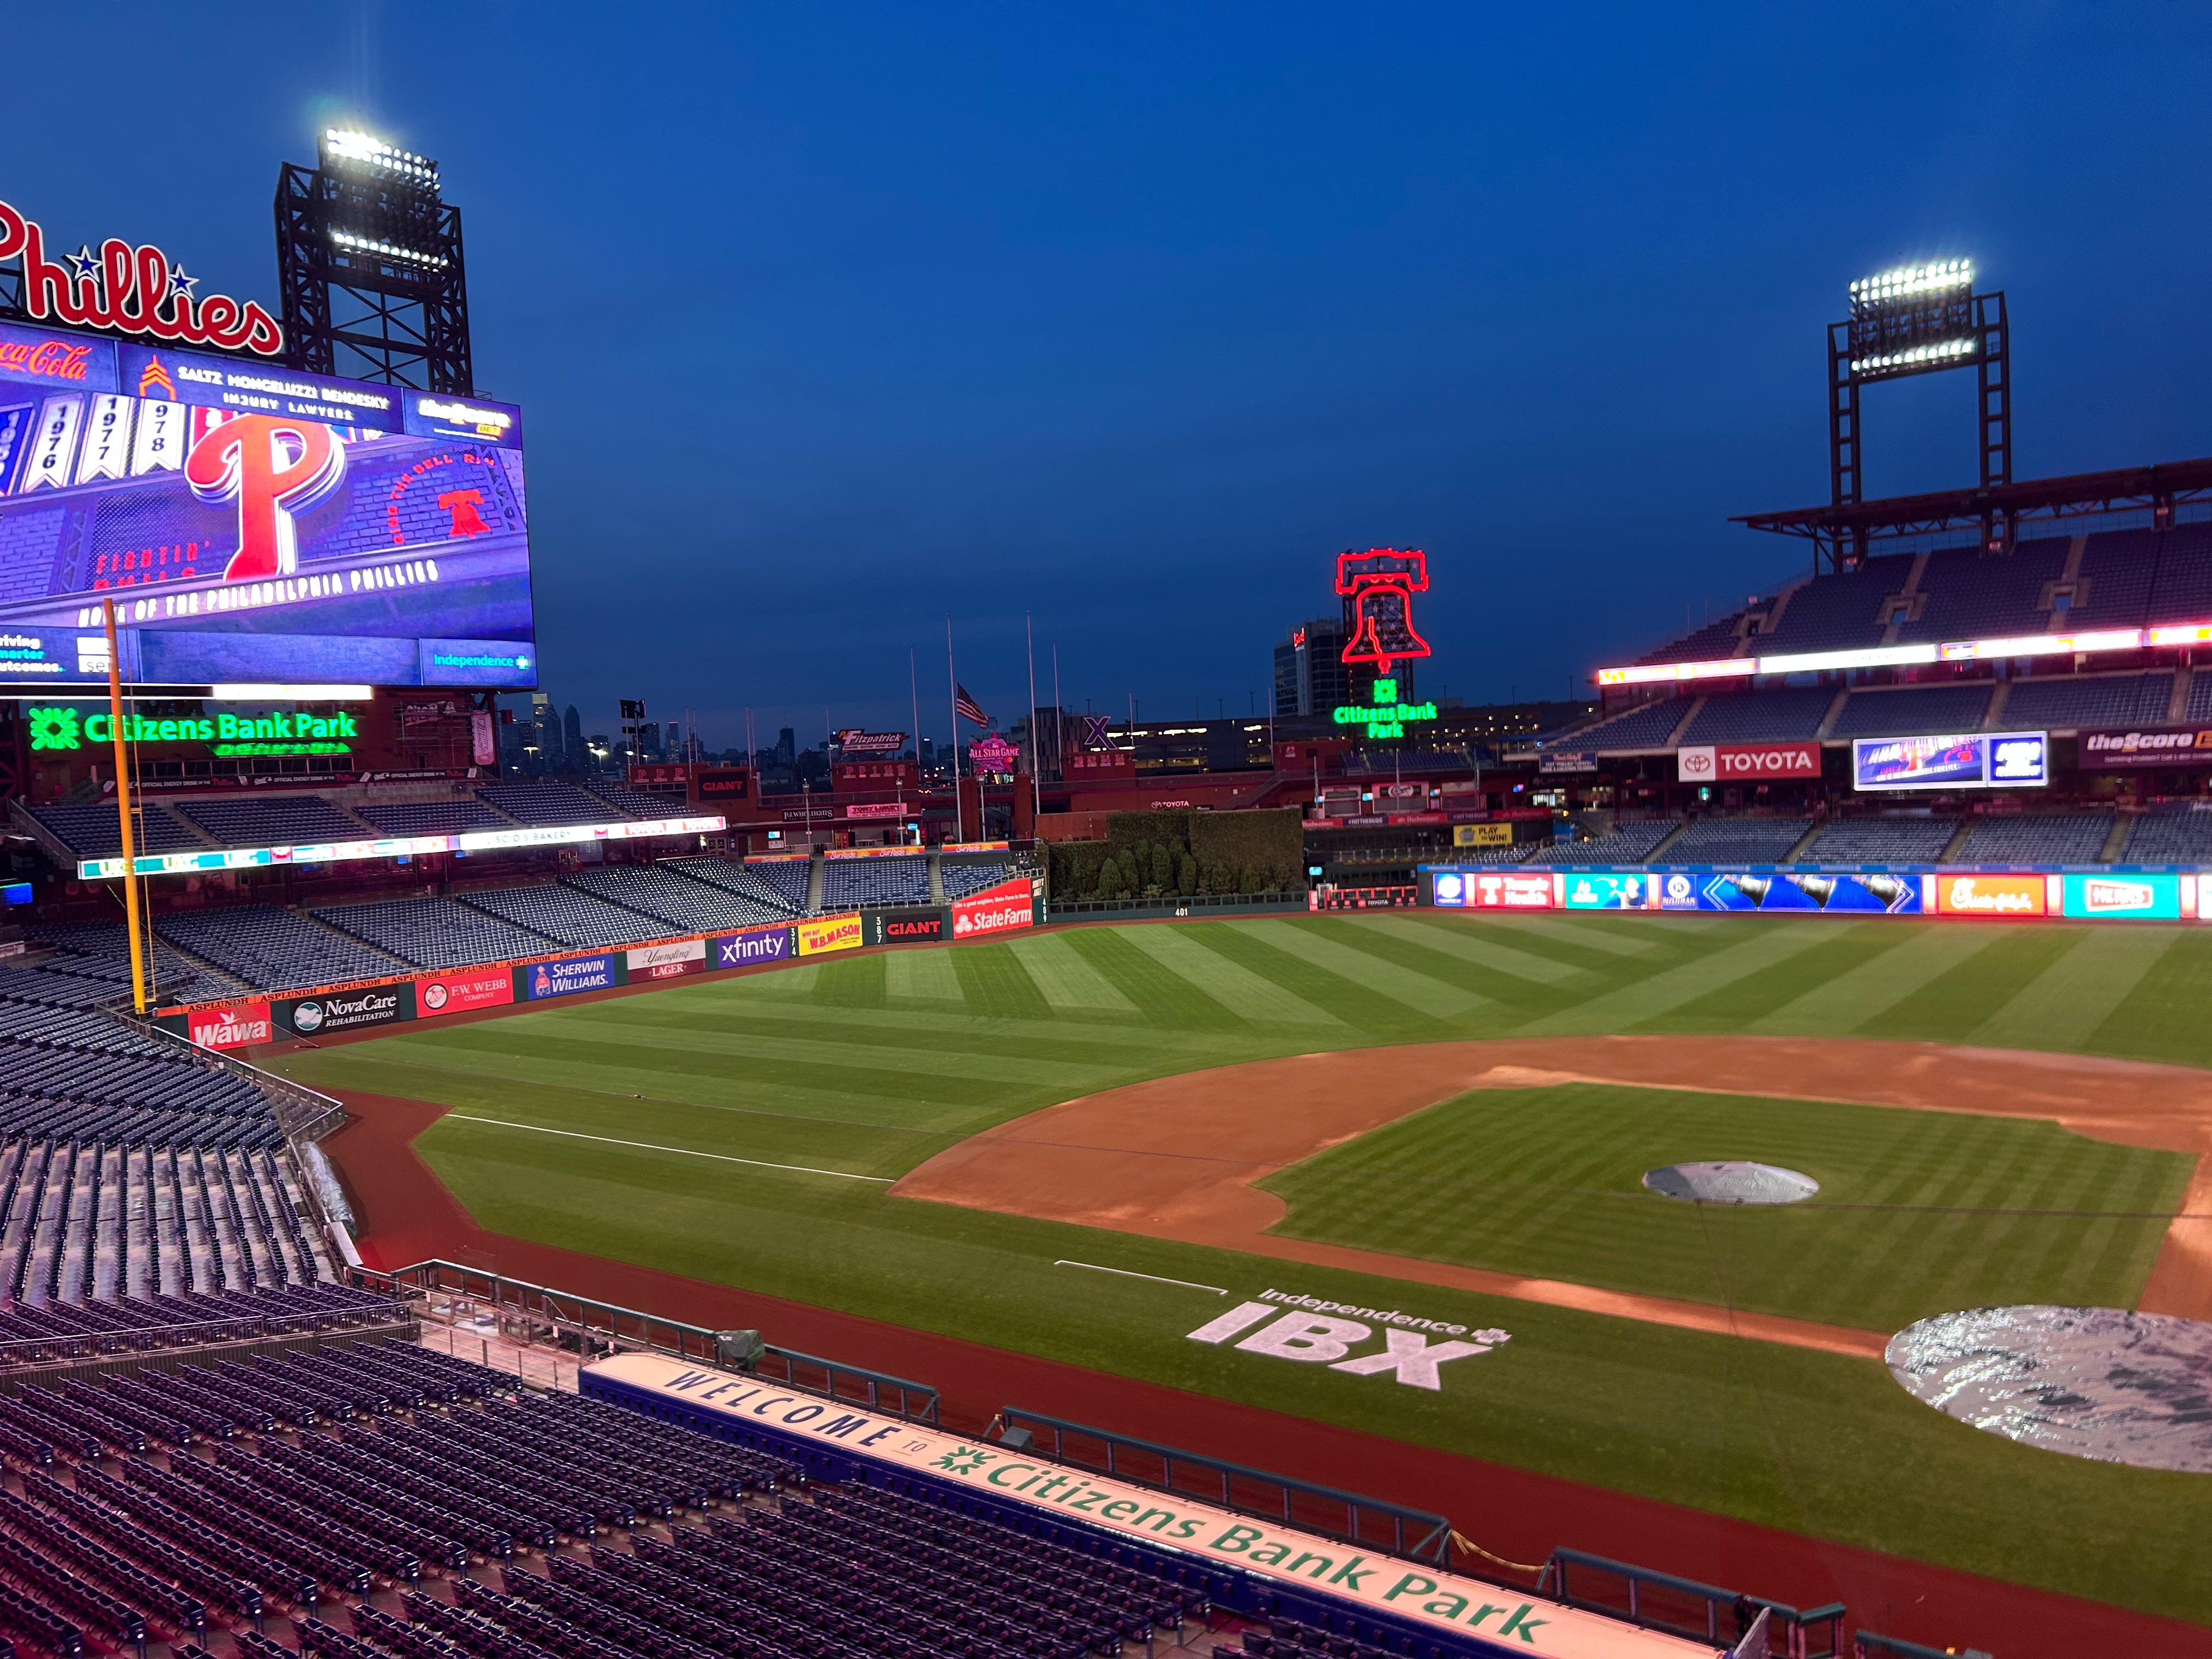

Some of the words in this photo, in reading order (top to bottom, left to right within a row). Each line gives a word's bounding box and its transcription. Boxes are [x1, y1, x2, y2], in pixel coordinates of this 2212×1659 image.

[0, 341, 92, 380] ca-Cola
[178, 366, 224, 385] SALTZ
[228, 374, 318, 399] MONGELUZZI
[321, 387, 390, 410] BENDESKY
[224, 392, 279, 410] INJURY
[289, 402, 354, 421] LAWYERS
[78, 604, 126, 628] HOE
[135, 598, 157, 620] OF
[166, 592, 198, 617] THE
[206, 572, 343, 611] PHILADELPHIA
[351, 559, 438, 592] PHILLIES
[434, 653, 514, 668] Independence
[1334, 706, 1396, 724] Citizens
[1396, 701, 1437, 721] Bank
[218, 712, 294, 740] Bank
[296, 710, 358, 738] Park
[1368, 720, 1404, 738] Park
[983, 748, 1001, 757] STAR
[1001, 747, 1020, 757] GAME
[1720, 751, 1813, 772] TOYOTA
[702, 781, 743, 792] GIANT
[1488, 833, 1506, 842] WIN!
[1175, 907, 1188, 916] 401
[887, 921, 940, 935] GIANT
[260, 988, 318, 1003] ASPLUNDH
[329, 979, 381, 992] ASPLUNDH
[391, 970, 441, 983] ASPLUNDH
[450, 963, 497, 975] ASPLUNDH
[506, 956, 550, 967] ASPLUNDH
[559, 948, 601, 960] ASPLUNDH
[609, 942, 649, 952] ASPLUNDH
[657, 935, 695, 945] ASPLUNDH
[701, 929, 738, 939] ASPLUNDH
[744, 923, 778, 933] ASPLUNDH
[785, 918, 818, 927] ASPLUNDH
[825, 913, 856, 921] ASPLUNDH
[642, 945, 692, 966] Yuengling
[722, 934, 784, 963] xfinity
[552, 960, 605, 978] SHERWIN
[652, 963, 684, 977] LAGER
[473, 979, 506, 992] WEBB
[552, 974, 606, 992] WILLIAMS
[324, 995, 397, 1017] NovaCare
[464, 992, 495, 1002] COMPANY
[325, 1010, 395, 1027] REHABILITATION
[194, 1020, 267, 1046] Wawa
[1258, 1288, 1469, 1335] Independence
[1186, 1301, 1493, 1390] IBX
[664, 1370, 903, 1447] WELCOME
[900, 1439, 928, 1453] TO
[986, 1462, 1207, 1540] Citizens
[1206, 1522, 1380, 1593] Bank
[1382, 1571, 1551, 1644] Park
